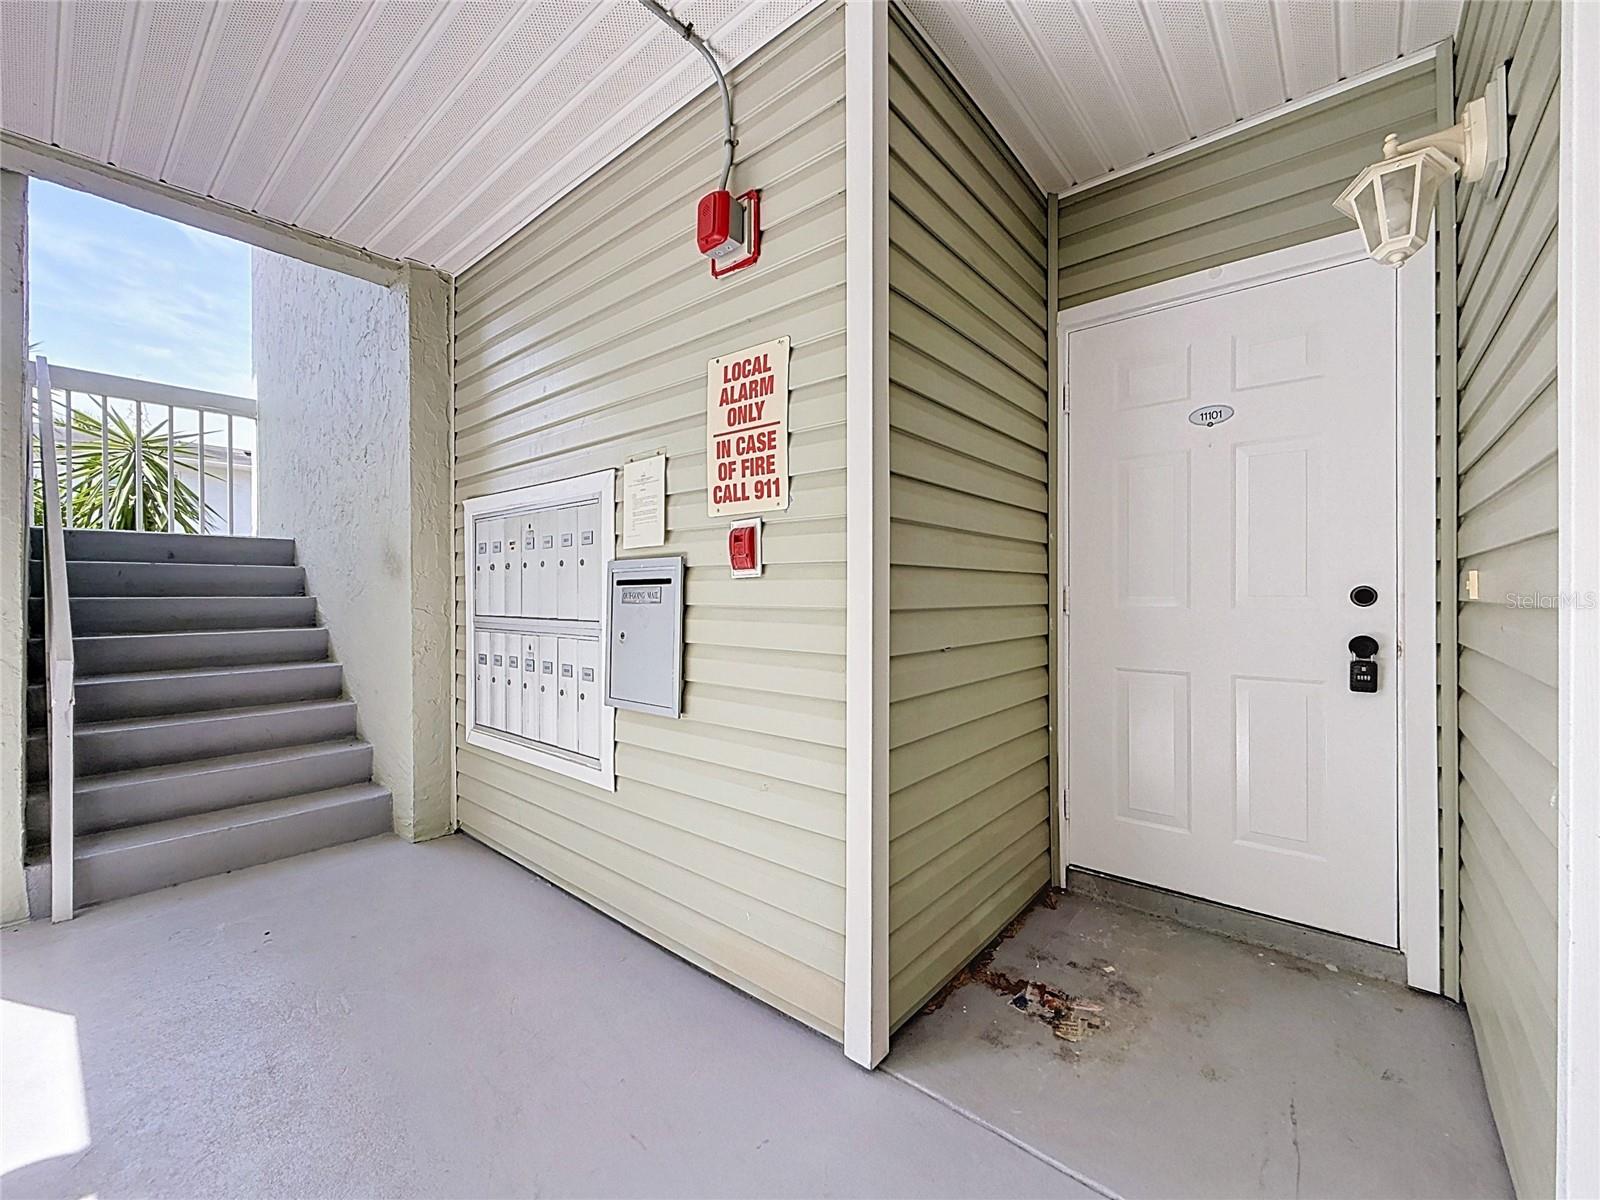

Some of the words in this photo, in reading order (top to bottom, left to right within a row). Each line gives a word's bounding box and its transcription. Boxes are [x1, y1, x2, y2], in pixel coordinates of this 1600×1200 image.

[723, 353, 772, 384] LOCAL
[719, 374, 775, 407] ALARM
[727, 400, 766, 427] ONLY
[1200, 409, 1222, 421] 11101
[716, 439, 731, 460] IN
[736, 430, 777, 456] CASE
[718, 460, 737, 482] OF
[741, 454, 776, 478] FIRE
[713, 482, 750, 505] CALL
[754, 477, 780, 500] 911
